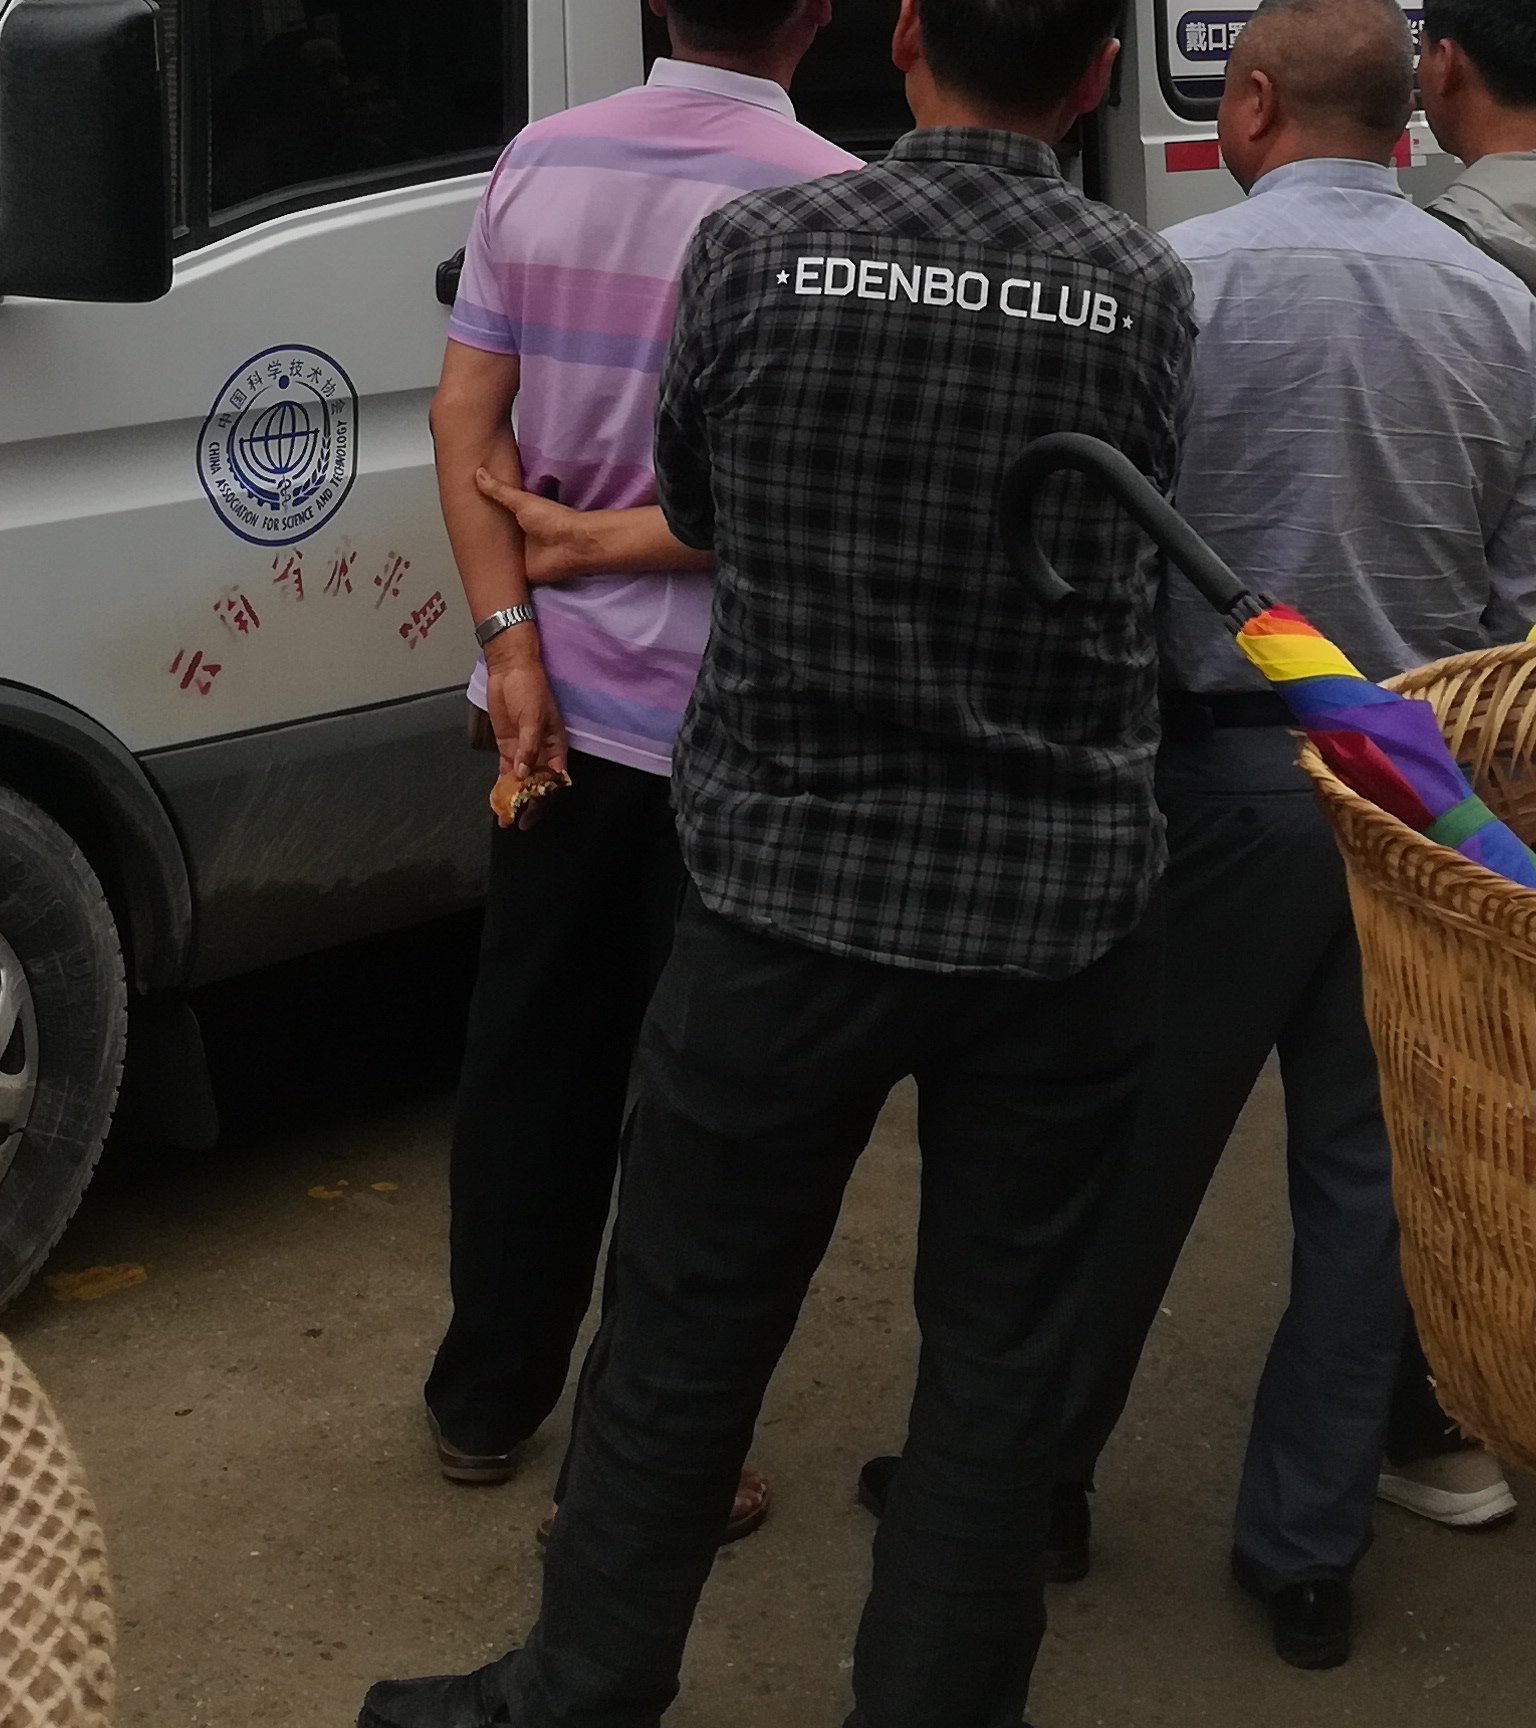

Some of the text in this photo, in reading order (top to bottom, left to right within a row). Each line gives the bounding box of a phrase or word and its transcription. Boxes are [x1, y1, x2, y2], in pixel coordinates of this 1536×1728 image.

[794, 256, 1118, 334] EDENBO CLUB
[218, 358, 347, 430] 中国科学技术协会
[207, 419, 349, 532] CHINA ASSOCIATION FOR SCIENCE AND TECHNOLOGY
